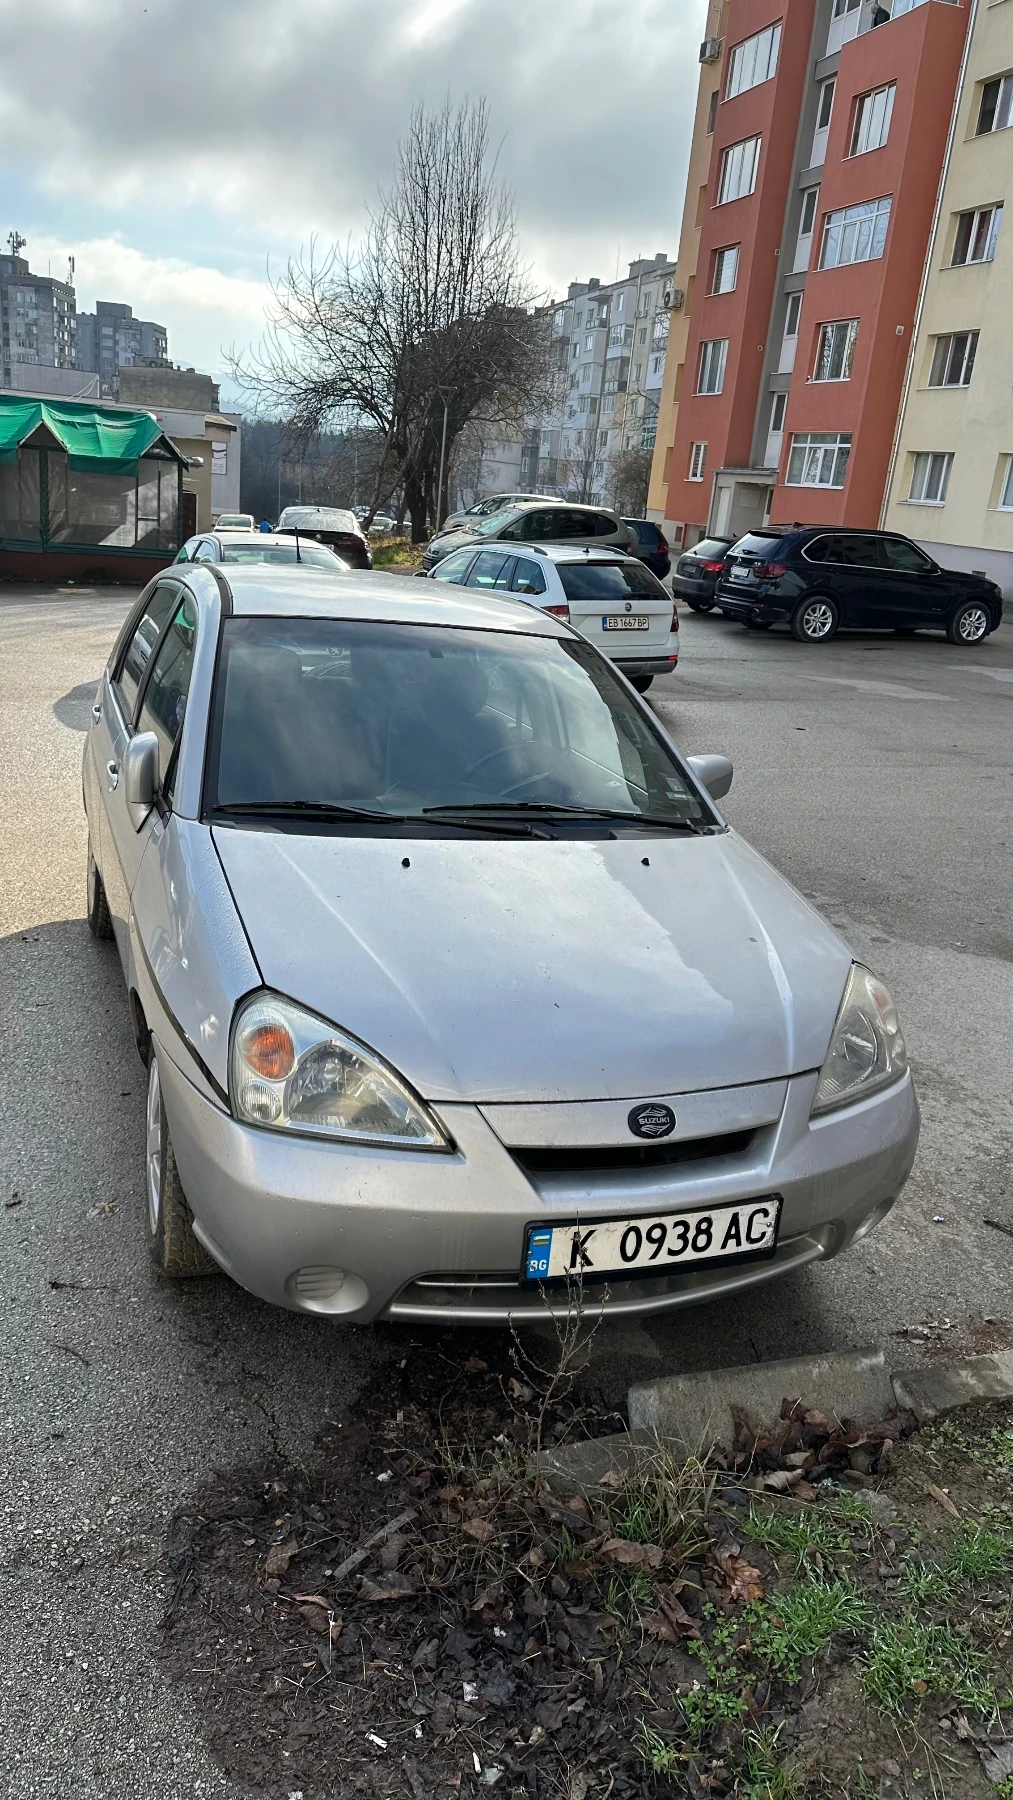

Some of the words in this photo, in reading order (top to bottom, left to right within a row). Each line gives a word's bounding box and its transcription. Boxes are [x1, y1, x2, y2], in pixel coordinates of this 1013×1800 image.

[608, 618, 618, 628] EB
[620, 618, 636, 628] 1667
[637, 618, 647, 628] BP
[638, 1117, 670, 1125] SUZUKI
[570, 1229, 596, 1269] K
[619, 1216, 713, 1262] 0938
[720, 1207, 770, 1250] AC
[529, 1259, 547, 1272] BG
